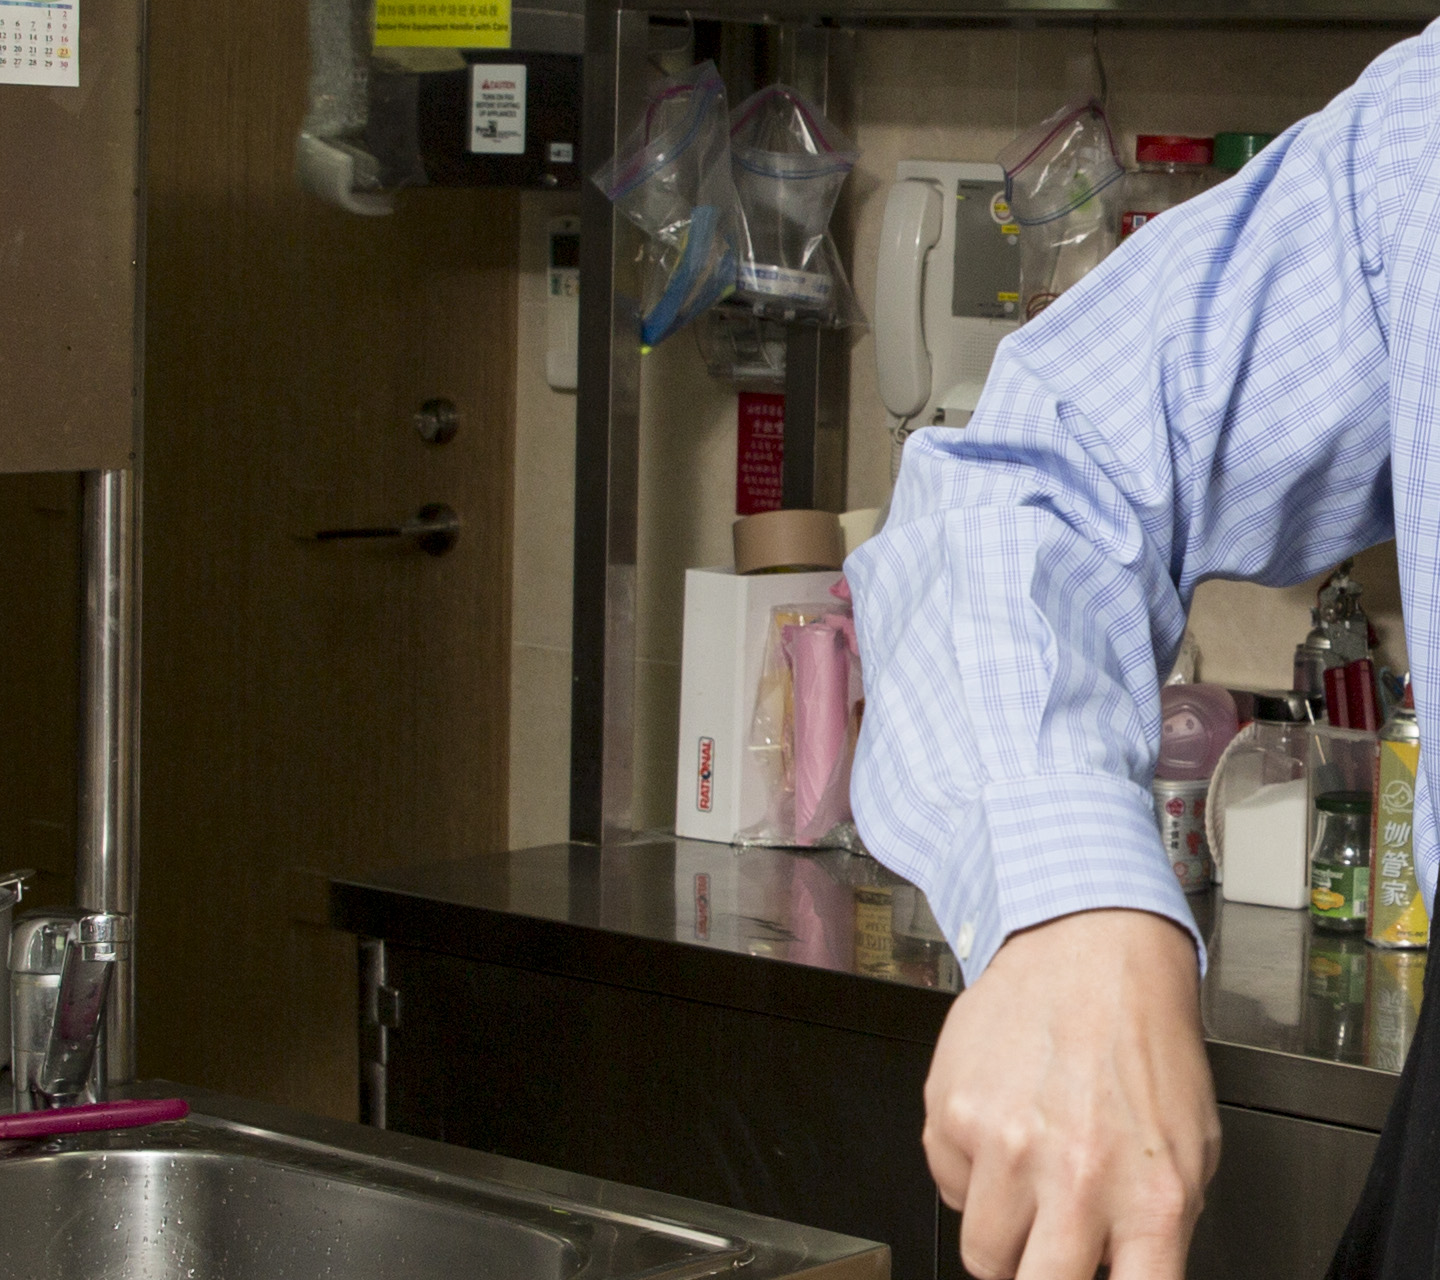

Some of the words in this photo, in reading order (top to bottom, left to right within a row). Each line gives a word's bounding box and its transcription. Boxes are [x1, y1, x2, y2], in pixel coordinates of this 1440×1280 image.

[700, 742, 711, 810] RATIONAL
[1381, 821, 1412, 906] 妙管家
